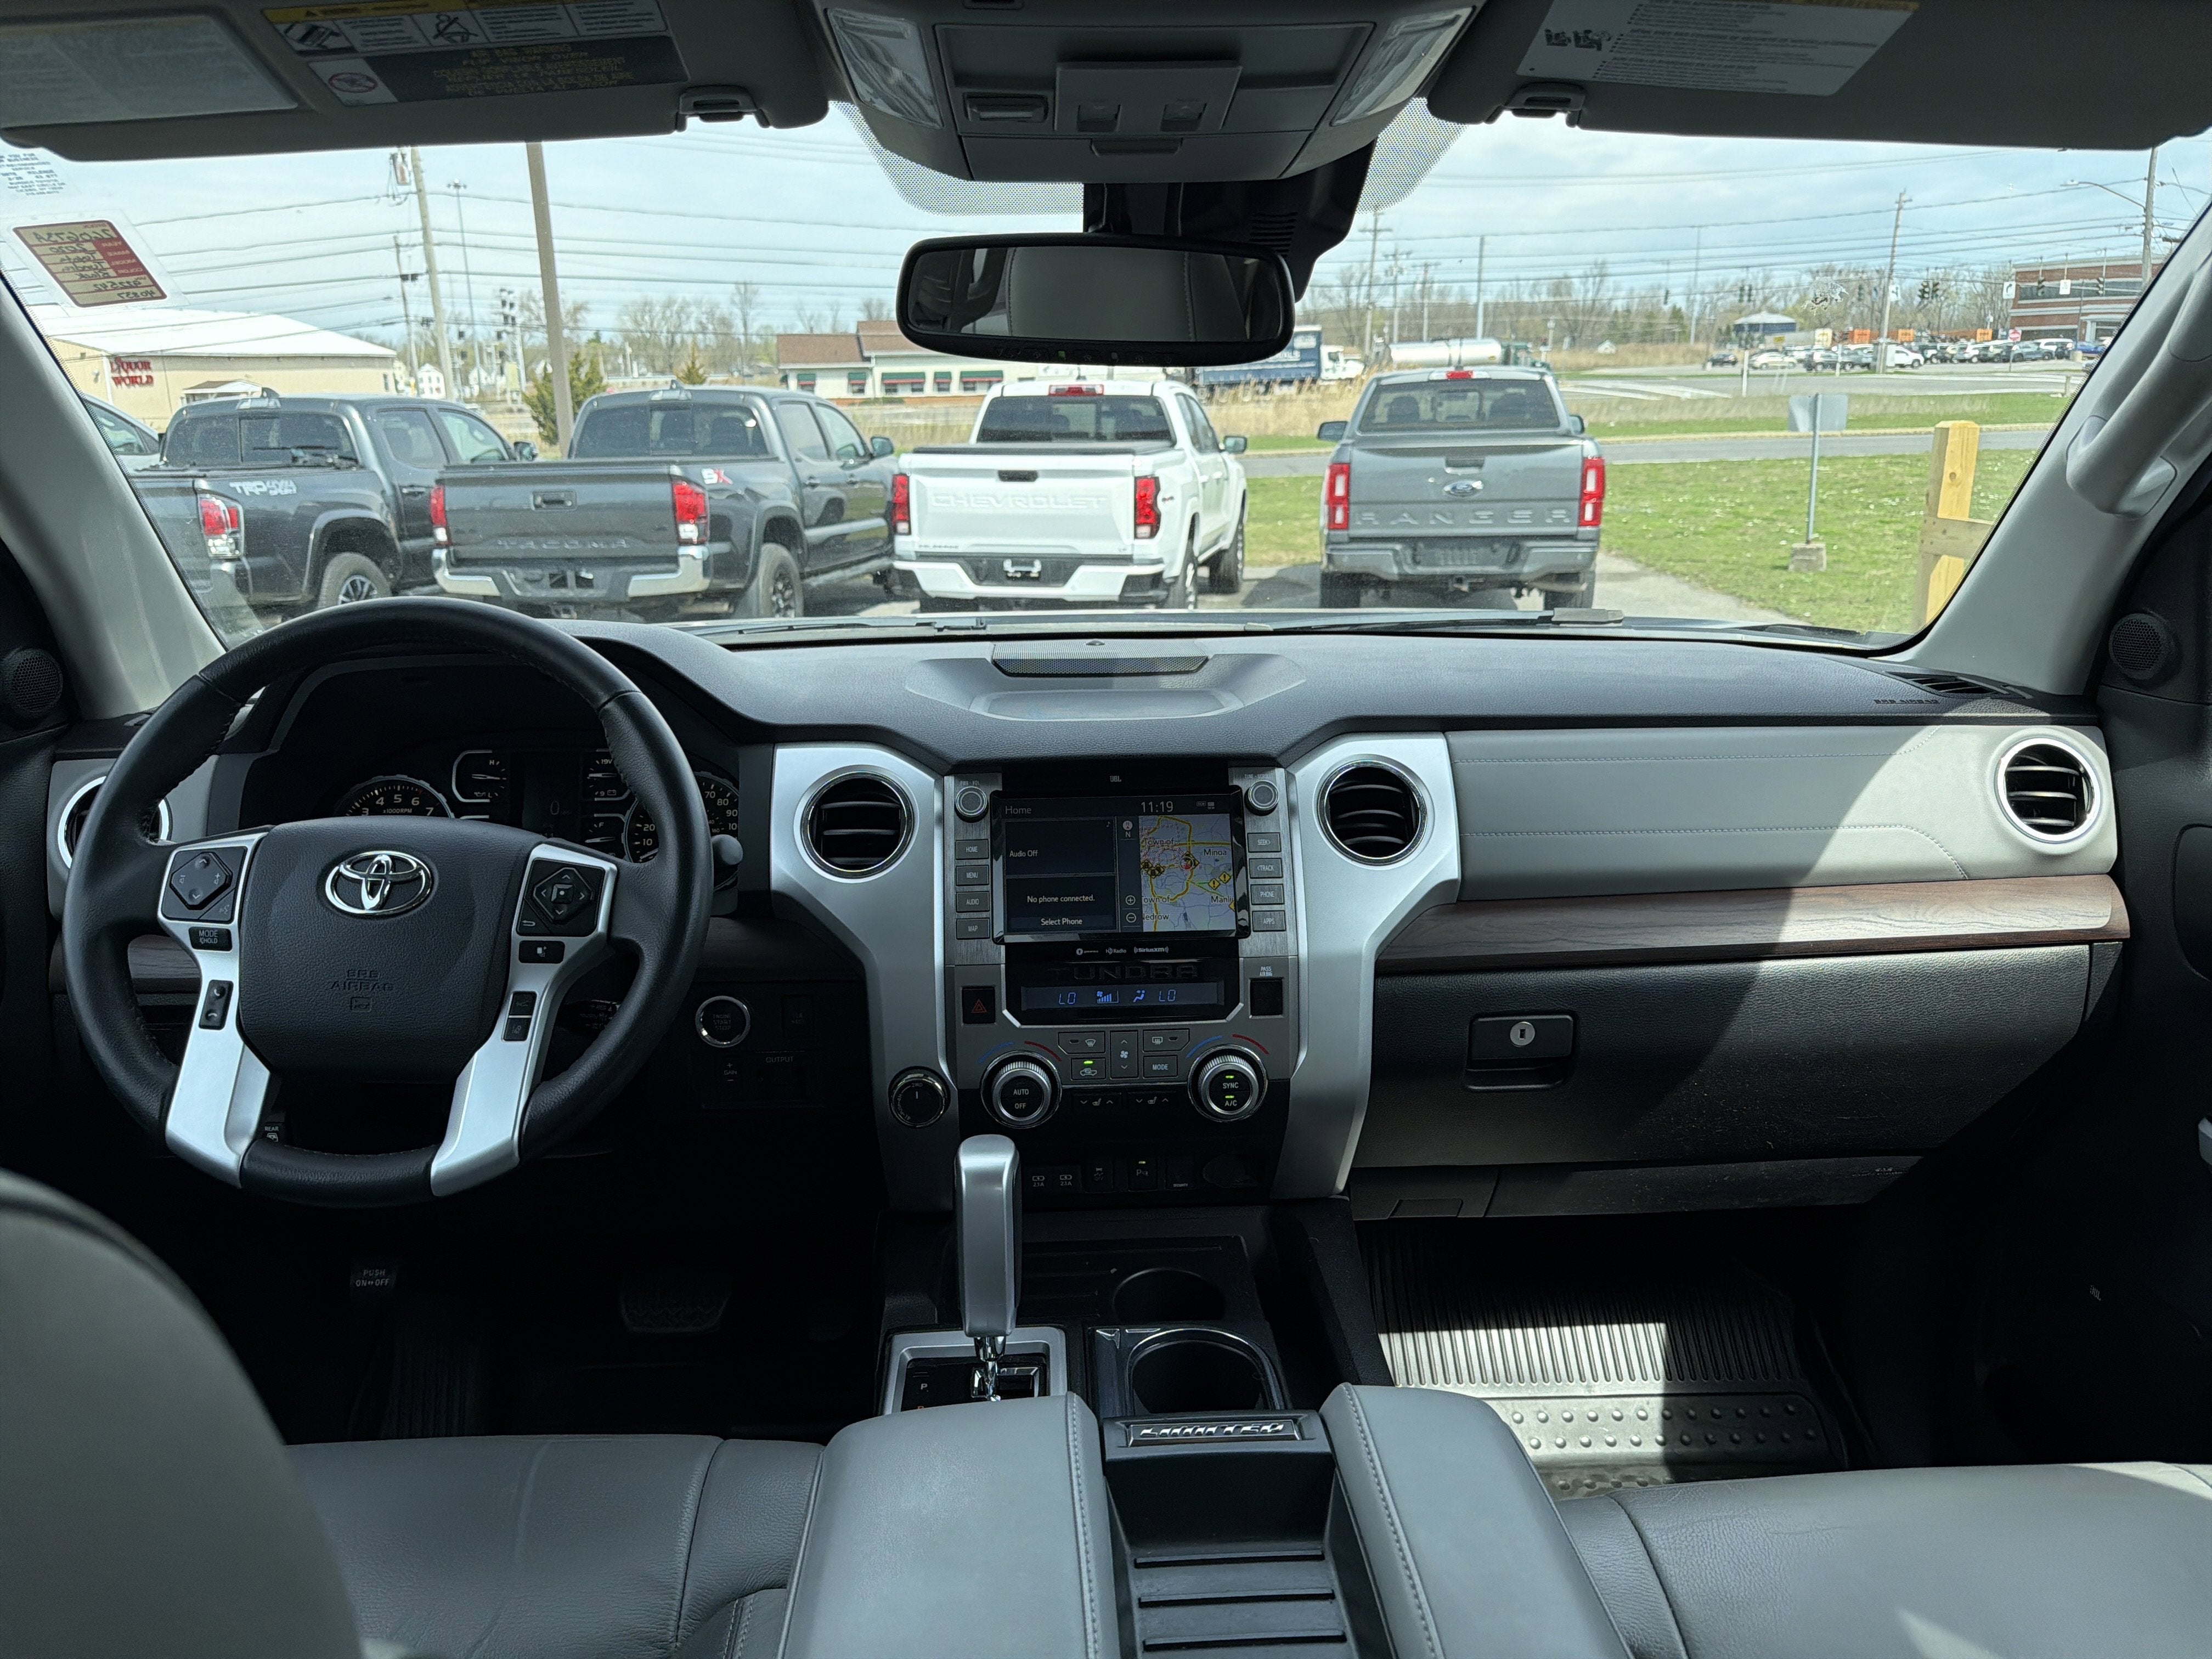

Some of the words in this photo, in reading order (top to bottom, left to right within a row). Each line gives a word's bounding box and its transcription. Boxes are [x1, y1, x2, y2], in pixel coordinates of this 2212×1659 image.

[111, 375, 154, 387] WORLD
[229, 481, 268, 496] TRD
[931, 494, 1107, 509] CHEVROLET
[1354, 509, 1571, 525] RANGER
[495, 539, 631, 550] TACOMA
[375, 797, 384, 806] 4
[393, 794, 402, 803] 5
[411, 797, 420, 806] 6
[716, 798, 729, 806] 80
[1005, 805, 1032, 815] Home
[1140, 800, 1174, 813] 11:19
[425, 807, 434, 816] 7
[643, 823, 656, 832] 20
[1167, 837, 1175, 845] of
[1039, 895, 1059, 904] phone
[199, 929, 218, 938] MODE
[1046, 963, 1199, 980] TUNDRA
[363, 1268, 386, 1277] PUSH
[355, 1279, 368, 1287] ON
[375, 1278, 391, 1286] OFF
